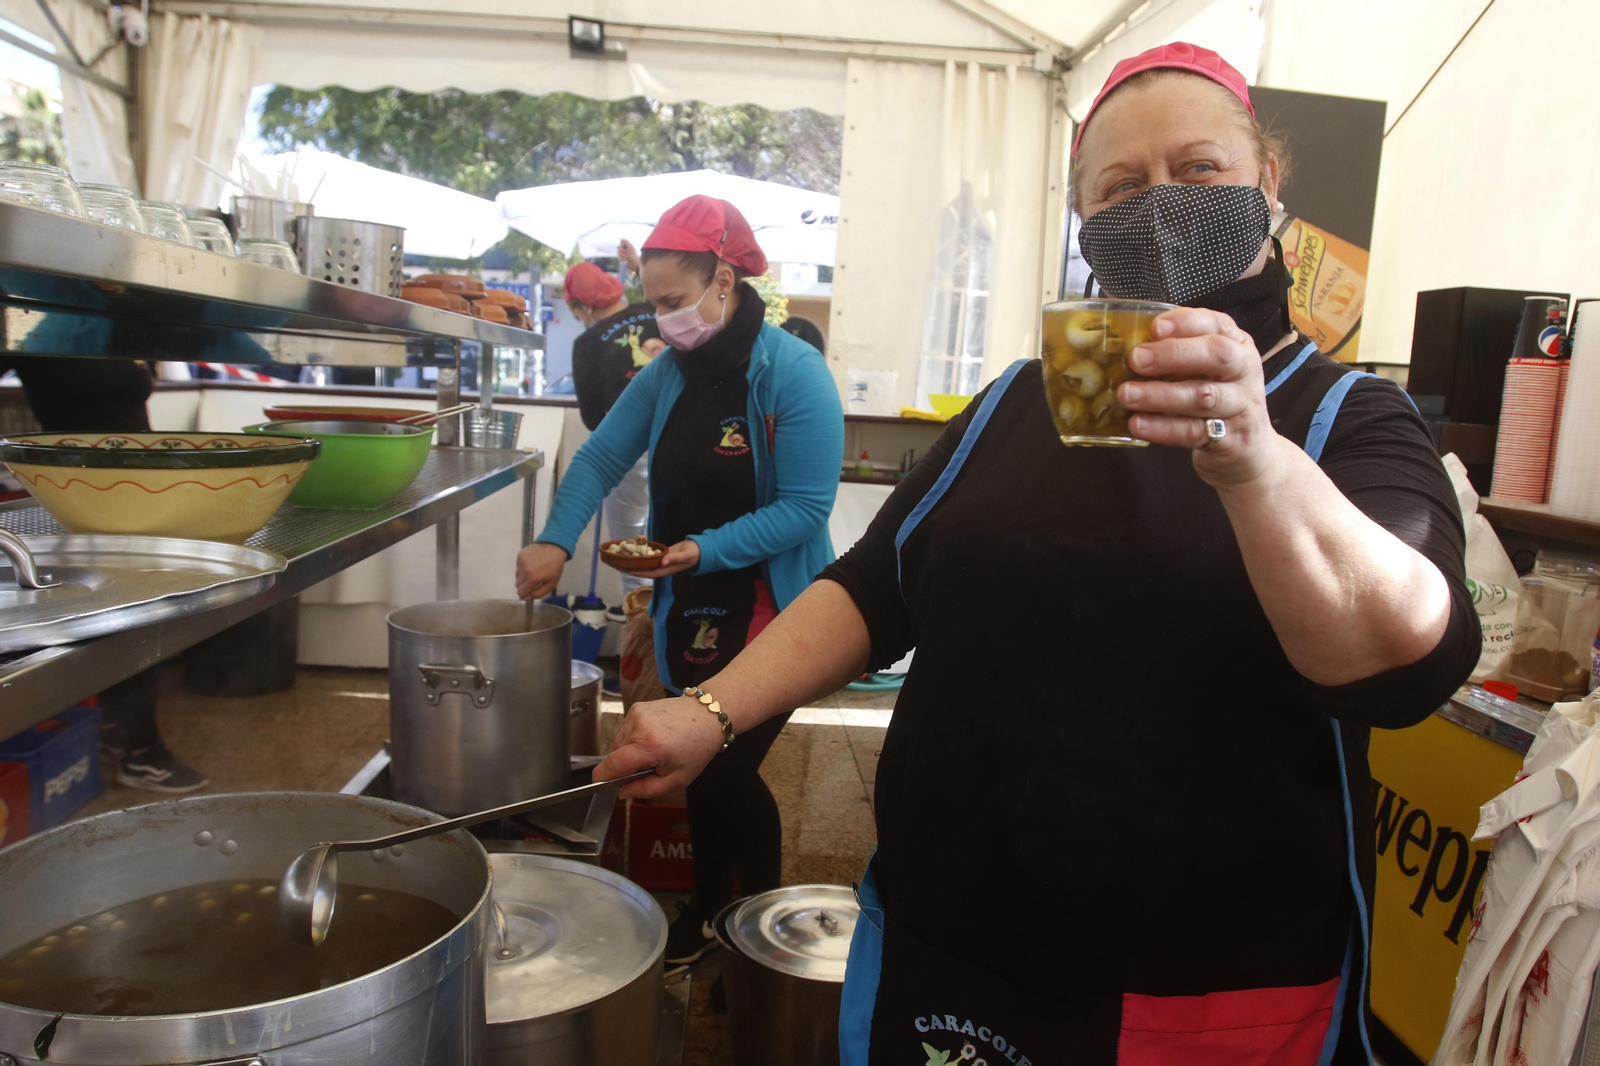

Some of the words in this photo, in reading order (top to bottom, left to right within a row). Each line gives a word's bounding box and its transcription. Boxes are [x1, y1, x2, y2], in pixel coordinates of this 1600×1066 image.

[1293, 233, 1320, 315] Schweppes
[1313, 267, 1345, 309] NARANJA
[1494, 622, 1513, 631] con
